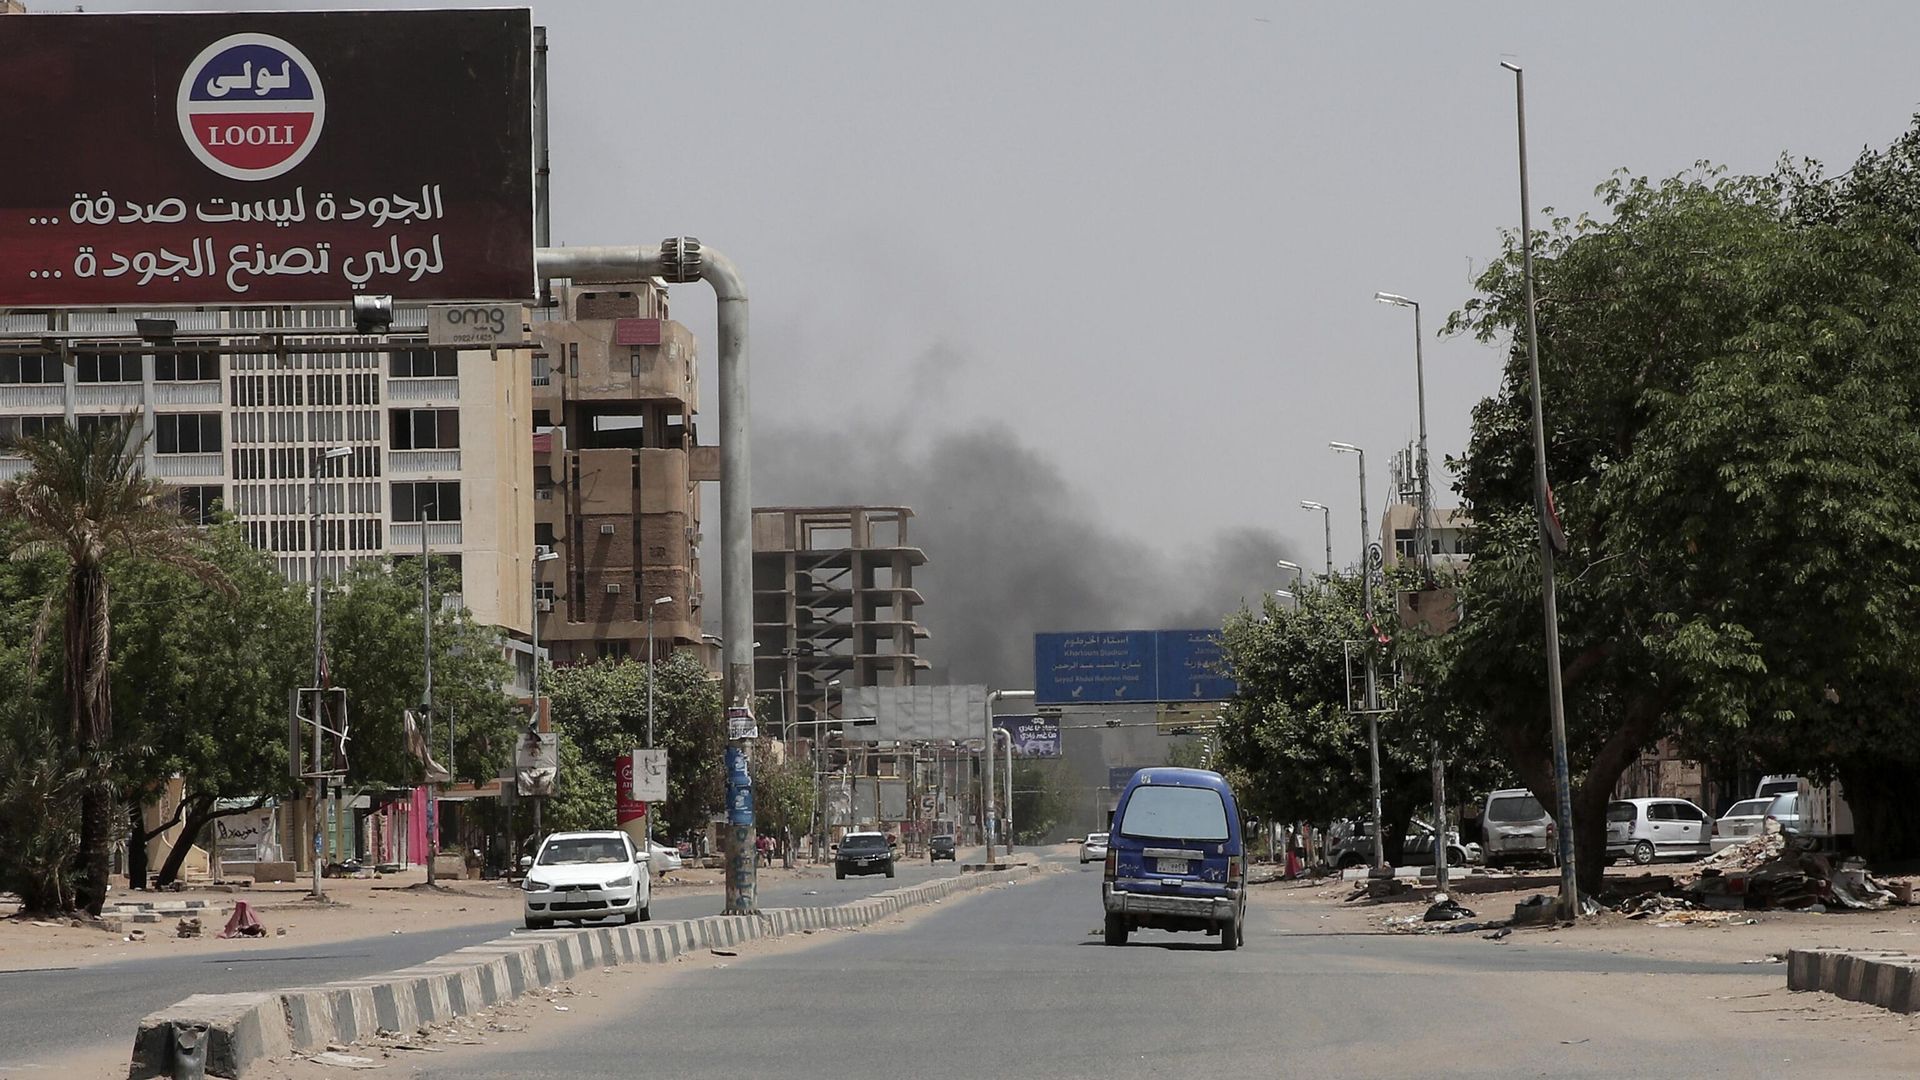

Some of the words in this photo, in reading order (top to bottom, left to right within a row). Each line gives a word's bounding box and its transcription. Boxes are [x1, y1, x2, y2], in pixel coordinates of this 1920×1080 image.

[208, 125, 295, 146] LOOLI
[70, 191, 187, 226] صدفة
[196, 187, 306, 228] ليست
[316, 184, 444, 229] الجودة
[74, 237, 216, 286] الجودة
[226, 242, 330, 294] تصنع
[343, 234, 444, 290] لولي
[447, 307, 505, 334] omg
